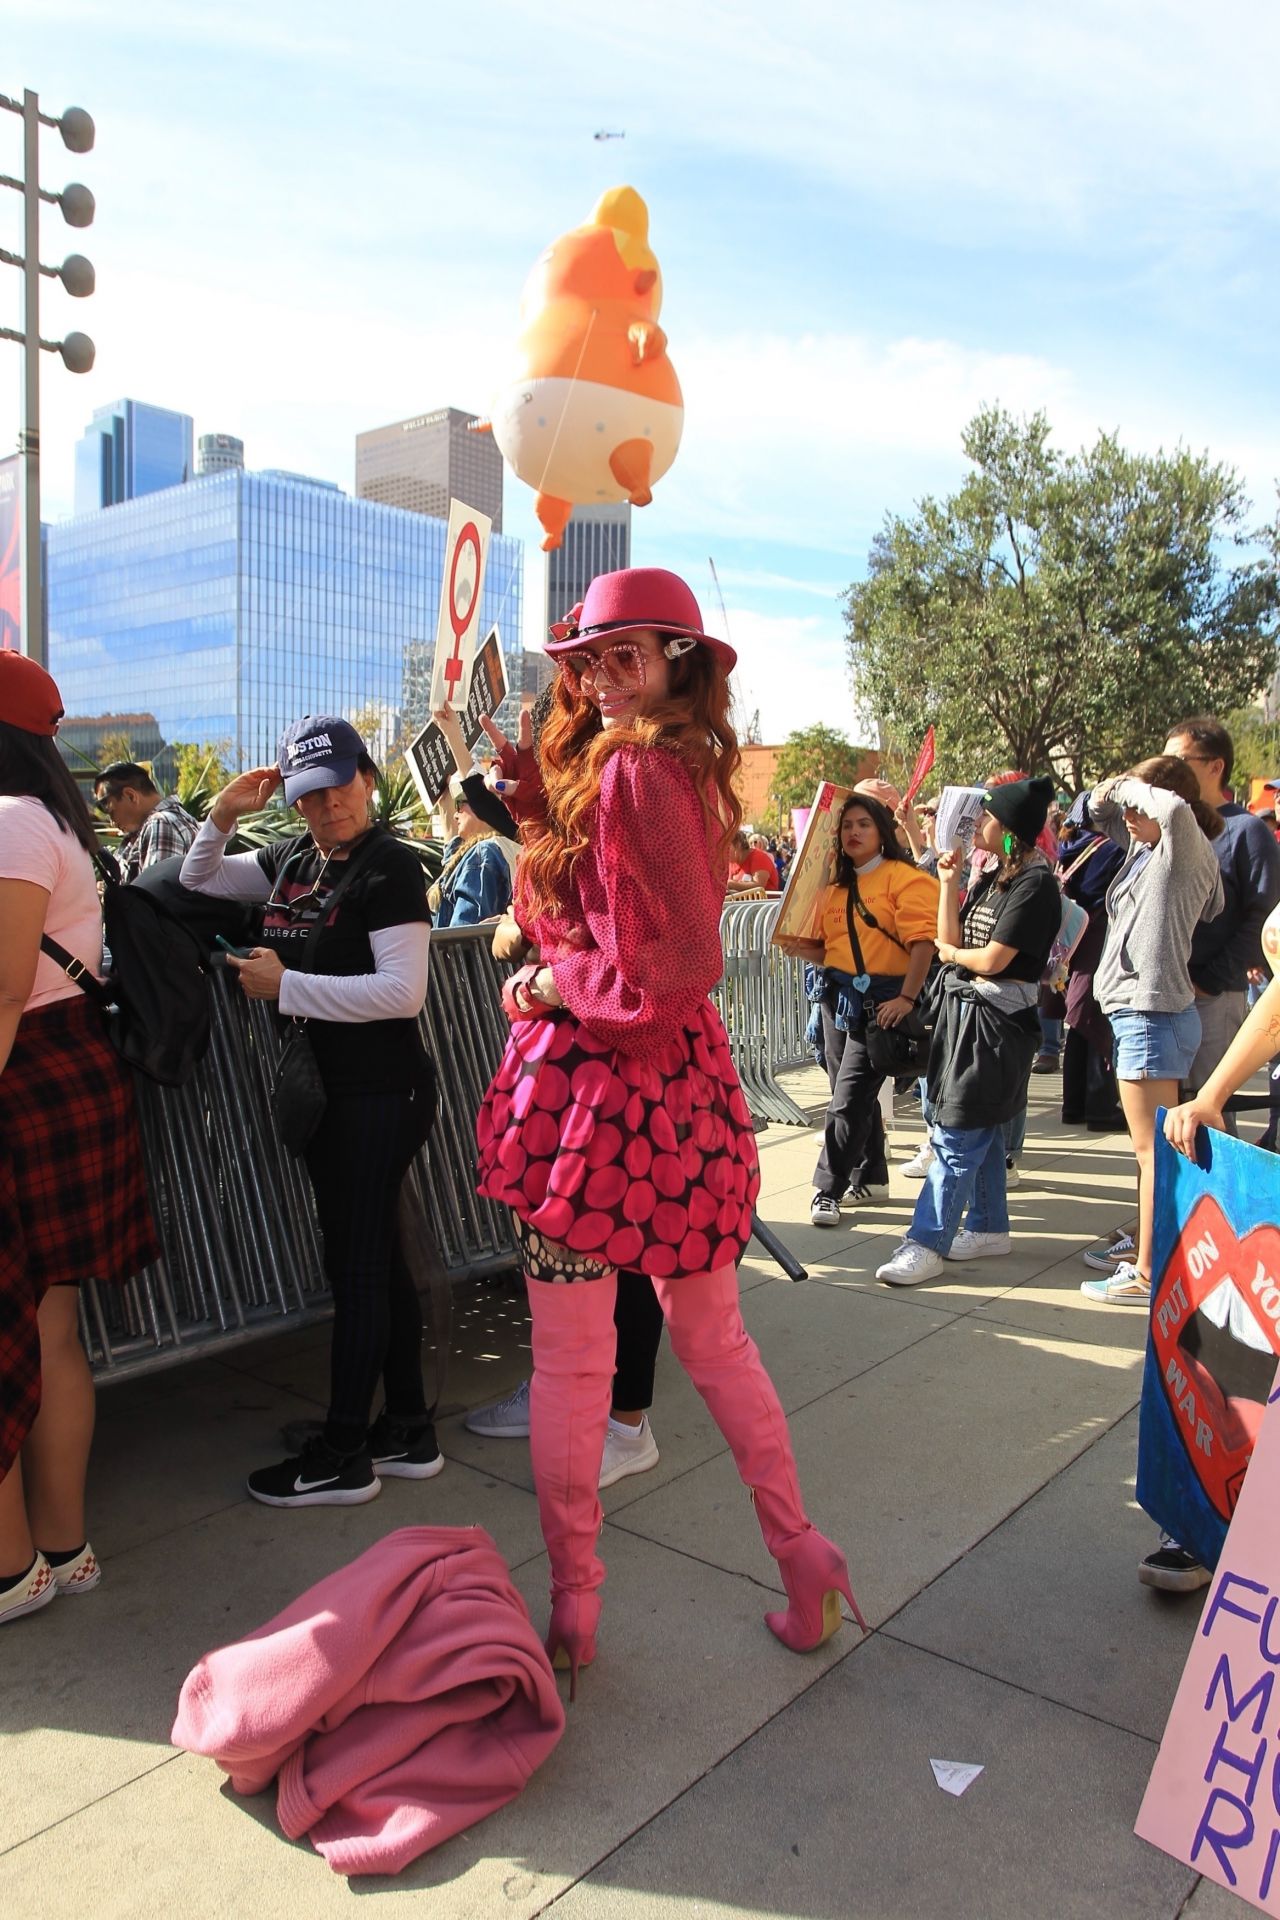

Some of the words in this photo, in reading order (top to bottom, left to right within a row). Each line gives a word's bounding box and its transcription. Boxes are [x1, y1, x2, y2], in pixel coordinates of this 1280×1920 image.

[287, 733, 333, 760] BOSTON
[263, 927, 309, 938] QUÉBEC
[1157, 1277, 1189, 1339] PUT
[1187, 1231, 1219, 1280] ON
[1251, 1260, 1280, 1340] YO
[1165, 1357, 1214, 1457] WAR
